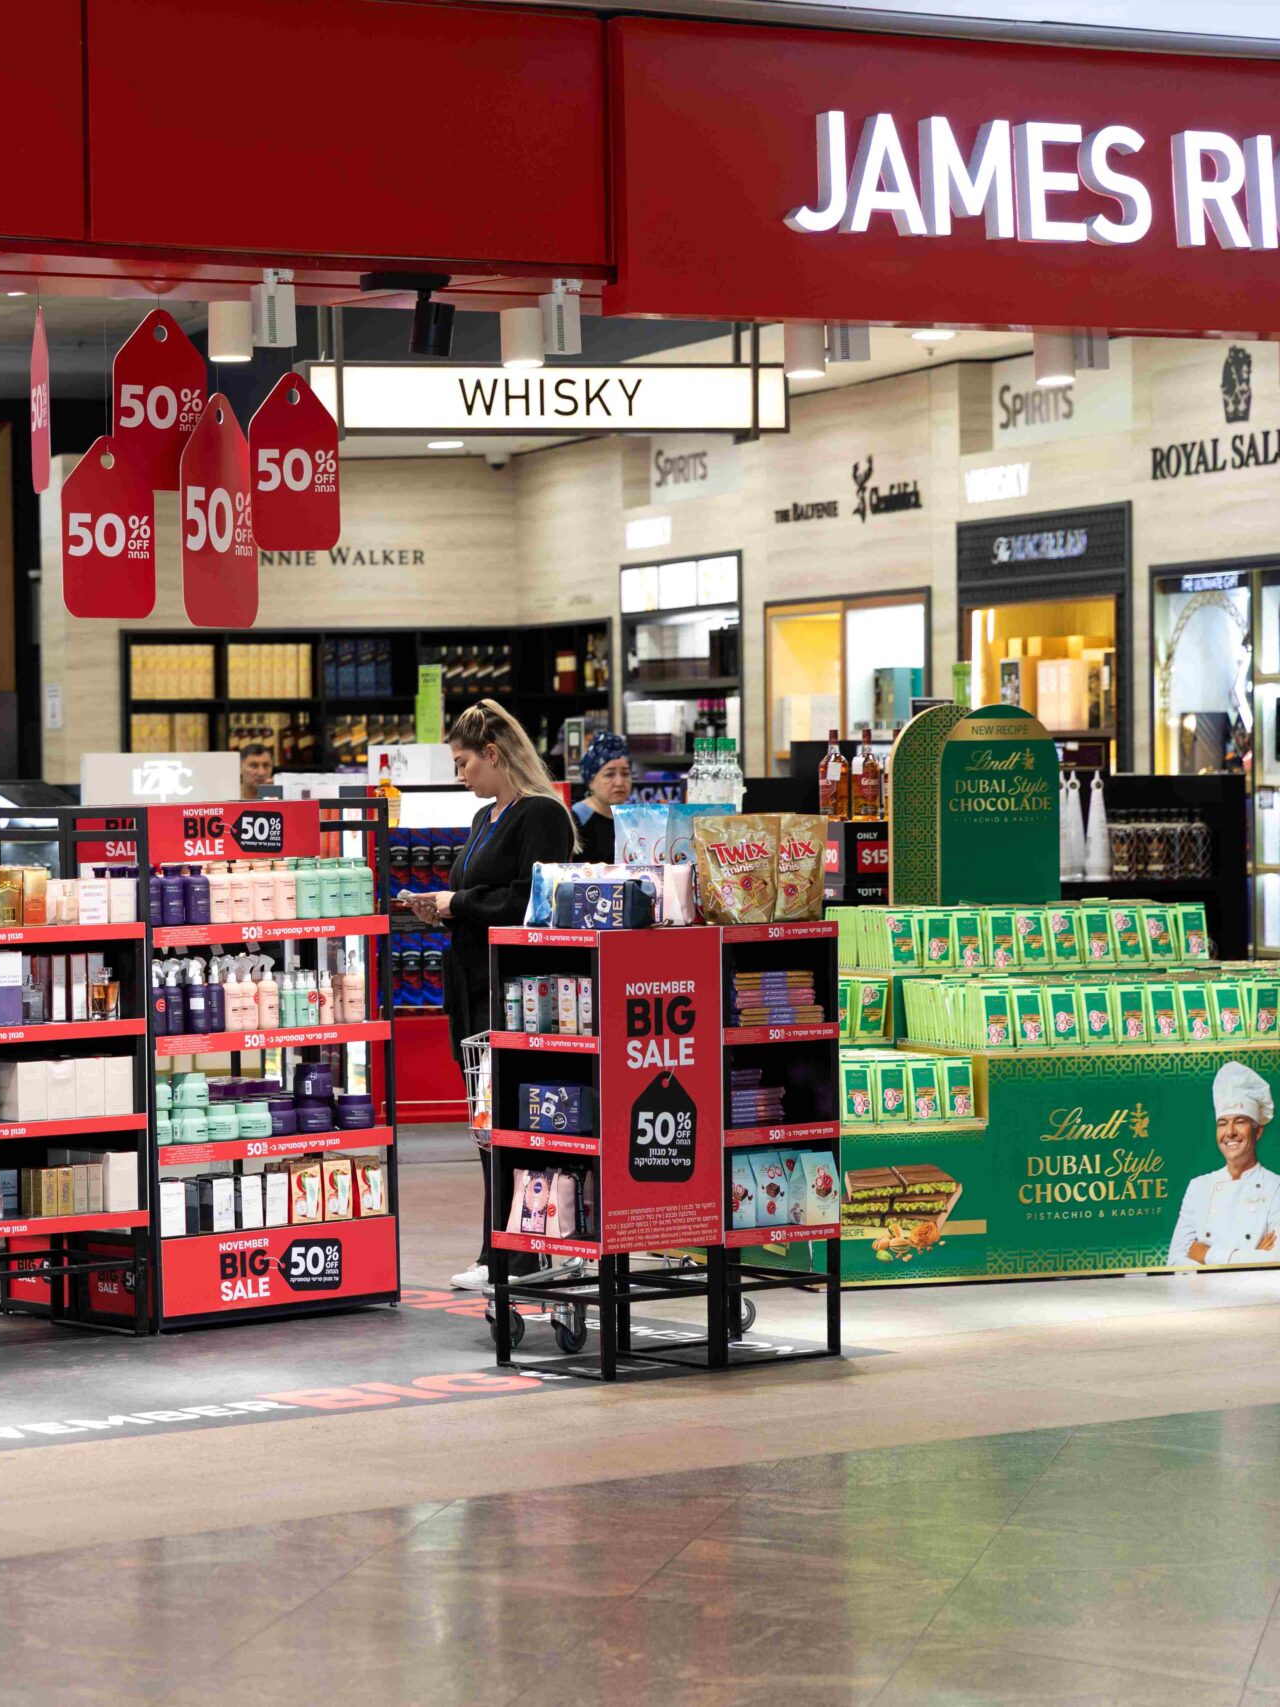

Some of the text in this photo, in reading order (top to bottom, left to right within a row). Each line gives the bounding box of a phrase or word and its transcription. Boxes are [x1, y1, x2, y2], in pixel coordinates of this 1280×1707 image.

[782, 110, 1280, 251] JAMES RI
[119, 384, 203, 430] 50%
[459, 378, 643, 417] WHISKY
[999, 385, 1073, 429] SPIRITS
[1151, 429, 1280, 480] ROYAL SAL
[257, 448, 336, 492] 50%
[314, 473, 335, 484] OFF
[655, 449, 708, 487] SPIRITS
[68, 512, 151, 558] 50%
[128, 540, 149, 550] OFF
[328, 546, 426, 565] WALKER
[971, 725, 1030, 735] NEW RECIPE
[965, 749, 1022, 772] Lindt
[955, 776, 1049, 799] DUBAI Style
[183, 808, 224, 817] NOVEMBER
[183, 816, 224, 839] BIG
[241, 816, 281, 841] 50%
[857, 832, 878, 840] ONLY
[184, 839, 224, 856] SALE
[612, 884, 624, 928] MEN
[626, 980, 695, 996] NOVEMBER
[626, 995, 696, 1037] BIG
[626, 1037, 695, 1070] SALE
[529, 1088, 541, 1129] MEN
[636, 1112, 691, 1145] 50%
[676, 1130, 691, 1138] OFF
[1040, 1106, 1128, 1141] Lindt
[649, 1147, 677, 1157] על מגוון
[671, 1157, 691, 1166] פריטי
[1027, 1148, 1165, 1182] DUBAI Style
[1018, 1177, 1169, 1205] CHOCOLATE
[1026, 1207, 1163, 1221] PISTACHIO & KADAYIF
[219, 1238, 269, 1252] NOVEMBER
[220, 1248, 270, 1280] BIG
[290, 1245, 339, 1276] 50%
[325, 1261, 338, 1269] OFF
[220, 1277, 271, 1301] SALE
[253, 1372, 543, 1409] BIG
